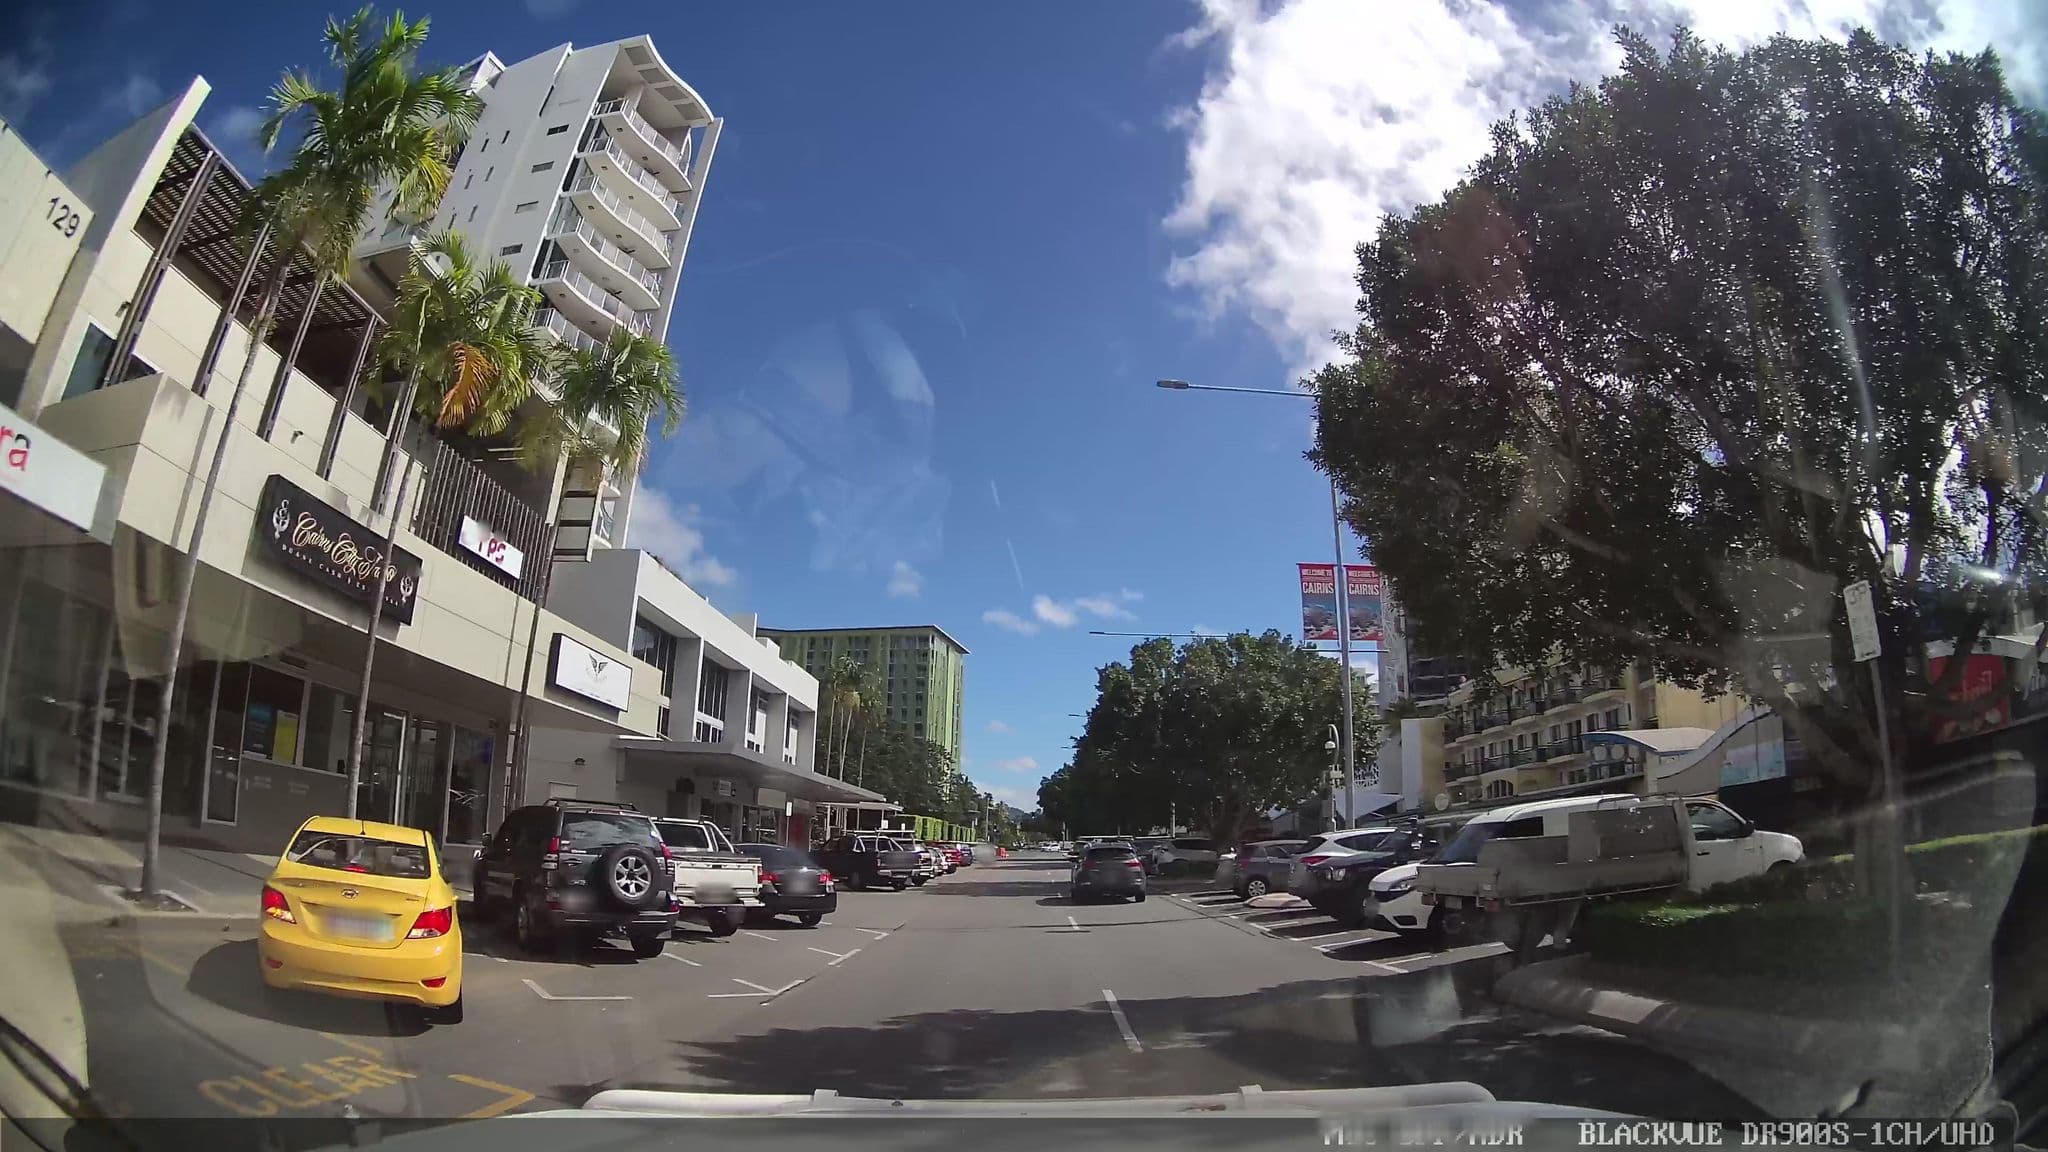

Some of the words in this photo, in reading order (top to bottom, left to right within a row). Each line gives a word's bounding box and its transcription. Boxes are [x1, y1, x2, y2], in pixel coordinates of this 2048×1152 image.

[46, 197, 80, 238] 129
[292, 511, 334, 554] Cairns
[331, 532, 362, 577] City
[1302, 582, 1334, 594] CAIRNS
[1348, 583, 1379, 595] CAIRNS
[199, 1056, 416, 1117] CLEAR
